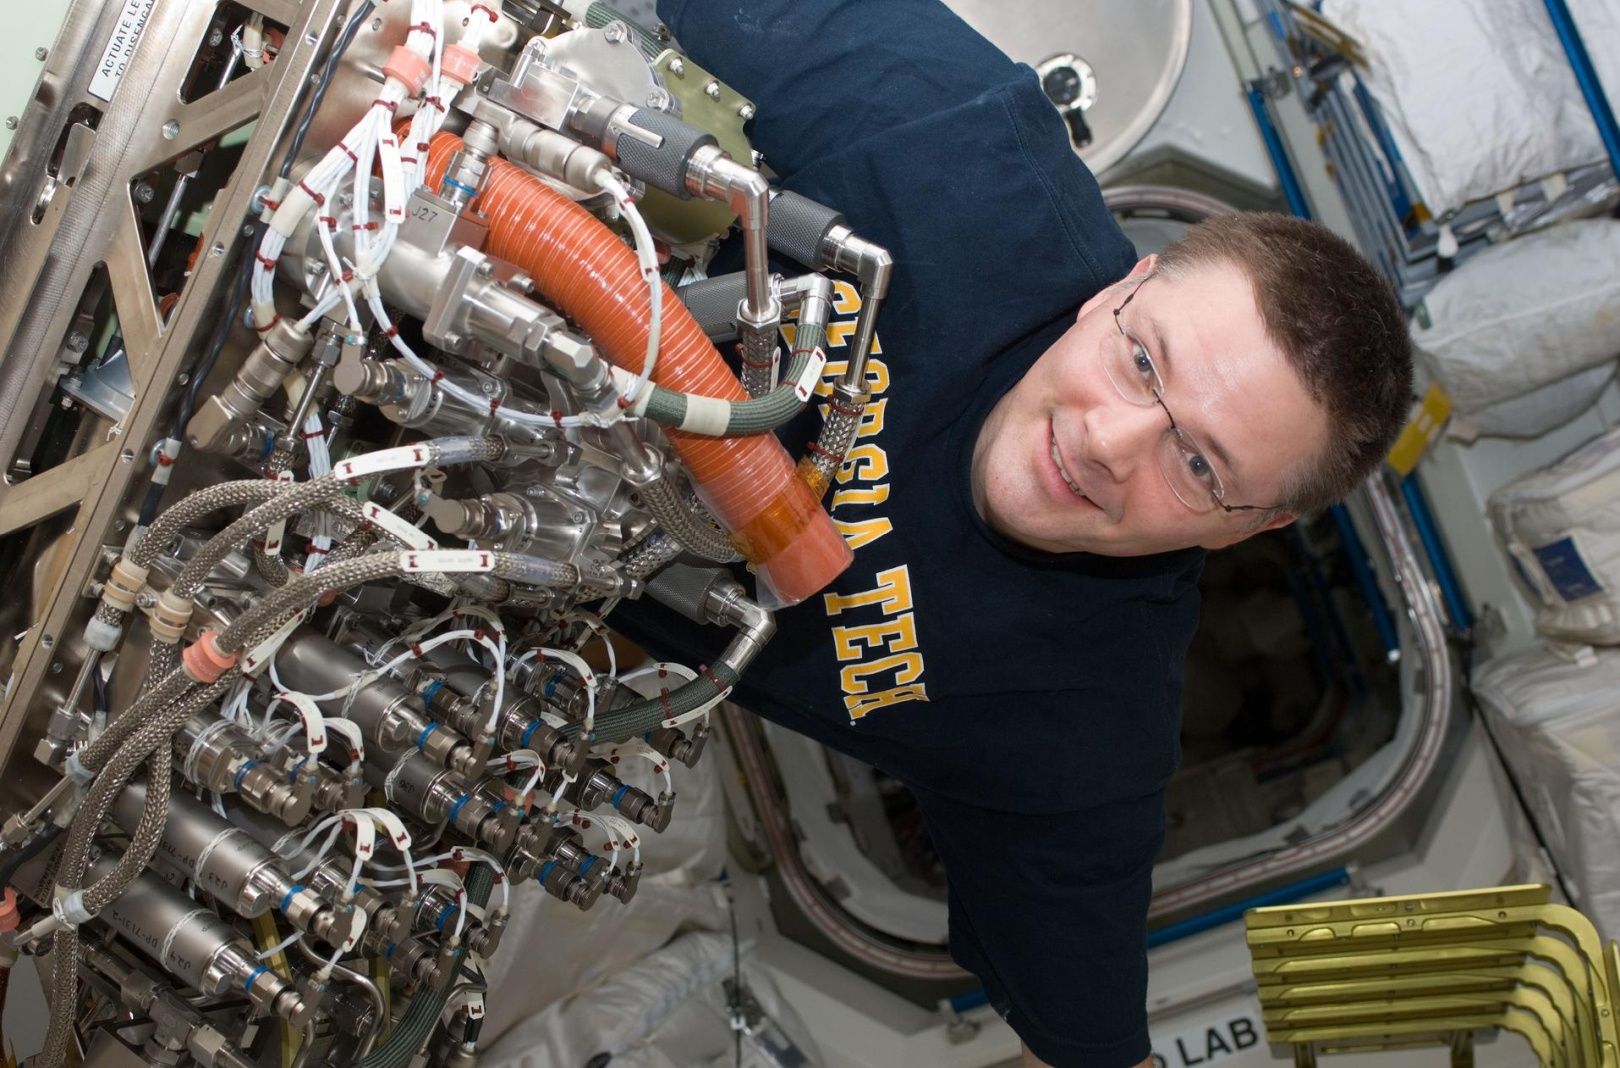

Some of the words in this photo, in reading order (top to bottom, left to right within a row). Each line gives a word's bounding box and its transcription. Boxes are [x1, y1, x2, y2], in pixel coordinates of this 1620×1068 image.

[101, 20, 132, 78] ACTUATE
[124, 0, 153, 57] DISENGA
[411, 206, 438, 223] J27
[824, 564, 930, 719] TECH
[1175, 1016, 1258, 1067] LAB
